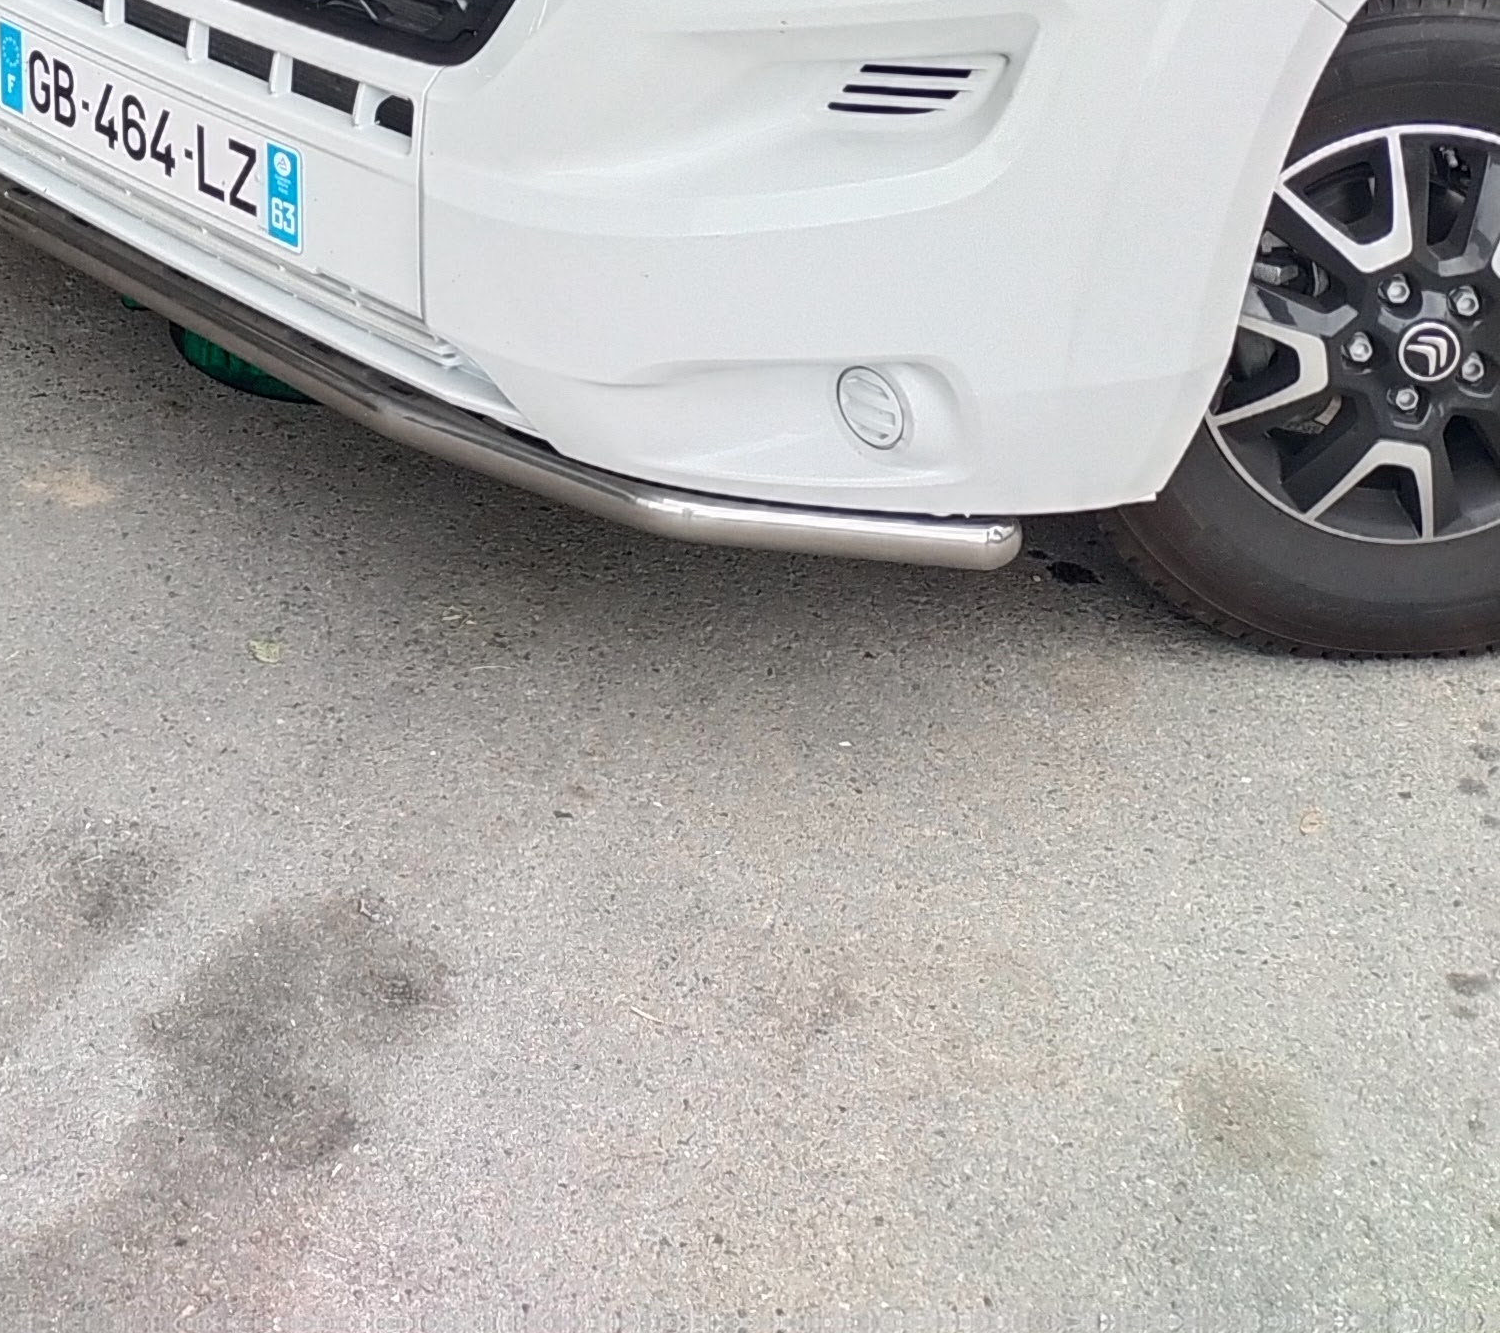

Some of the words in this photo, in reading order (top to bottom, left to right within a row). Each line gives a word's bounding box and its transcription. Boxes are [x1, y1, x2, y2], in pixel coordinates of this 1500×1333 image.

[7, 73, 16, 95] F
[28, 49, 258, 217] GB-464-LZ
[271, 196, 296, 236] 63
